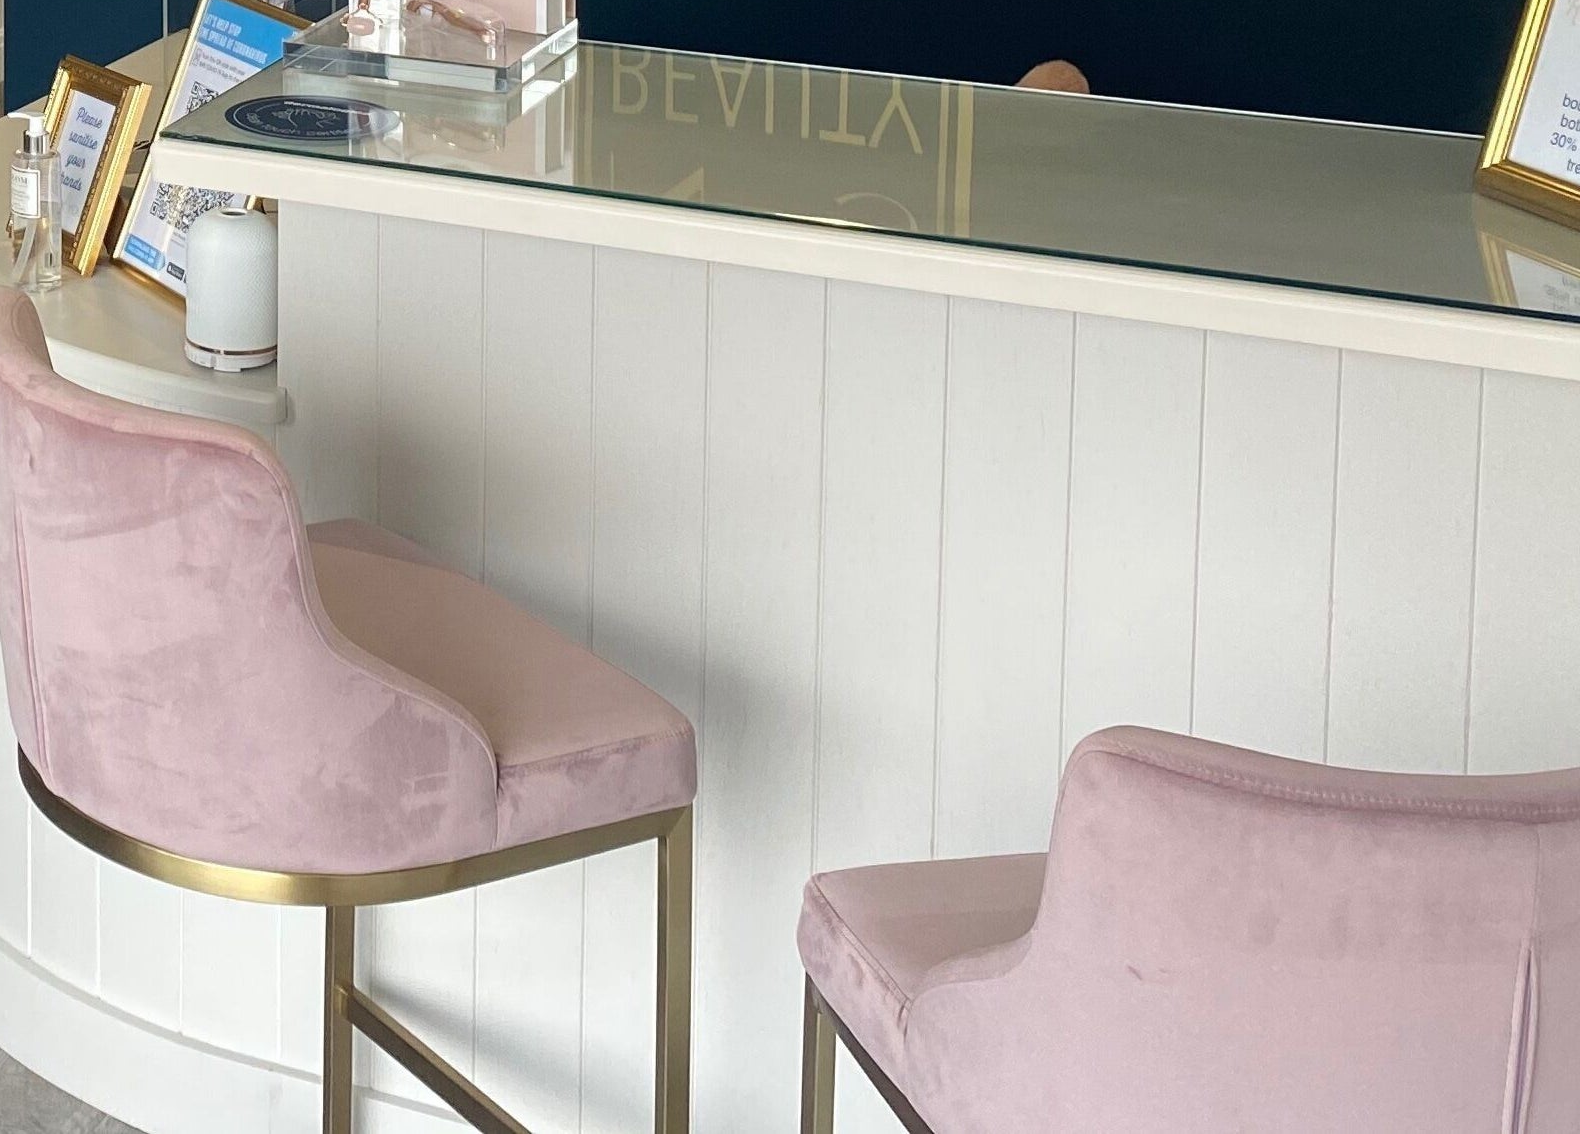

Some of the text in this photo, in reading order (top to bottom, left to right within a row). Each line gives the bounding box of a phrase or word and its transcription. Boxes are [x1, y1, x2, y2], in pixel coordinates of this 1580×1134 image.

[76, 106, 103, 129] Please
[68, 131, 99, 150] sanitise
[1550, 132, 1578, 151] 30%
[64, 153, 86, 170] your
